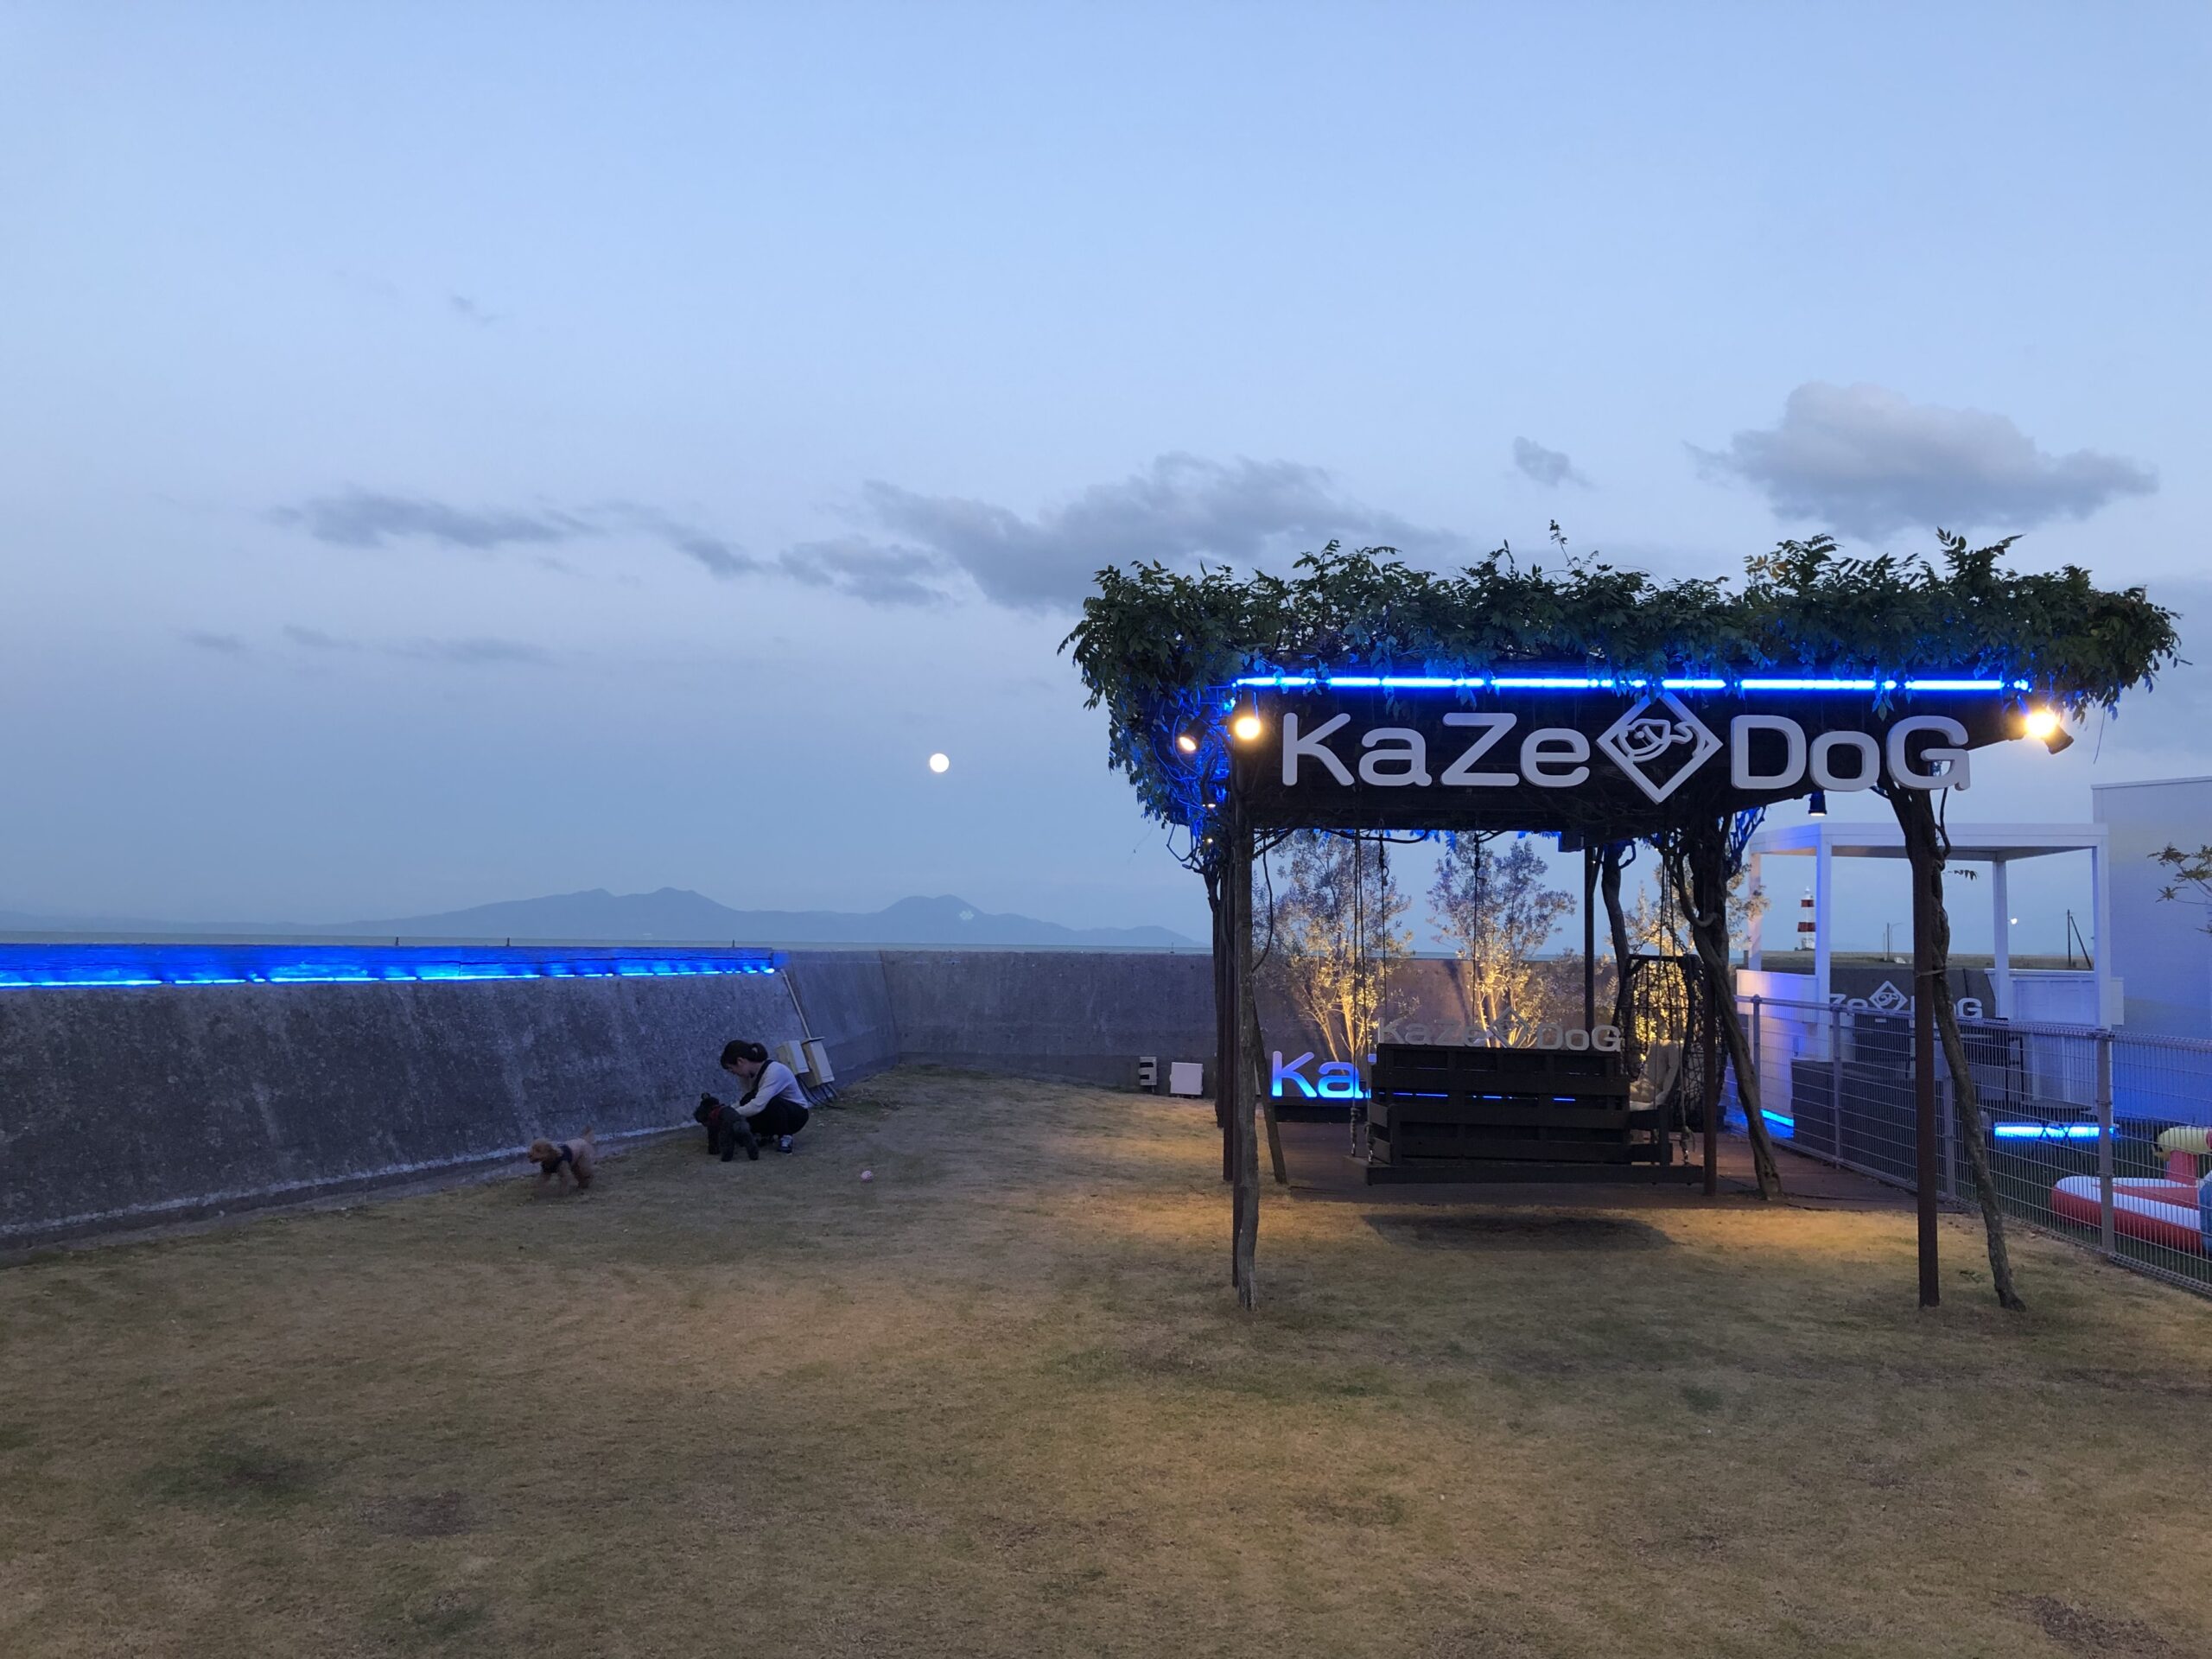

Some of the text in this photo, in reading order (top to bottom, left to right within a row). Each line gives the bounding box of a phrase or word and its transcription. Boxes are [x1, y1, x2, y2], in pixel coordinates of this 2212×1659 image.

[1282, 712, 1970, 791] KaZe DoG
[1378, 1017, 1621, 1052] KaZe DoG
[1272, 1051, 1372, 1098] Ka
